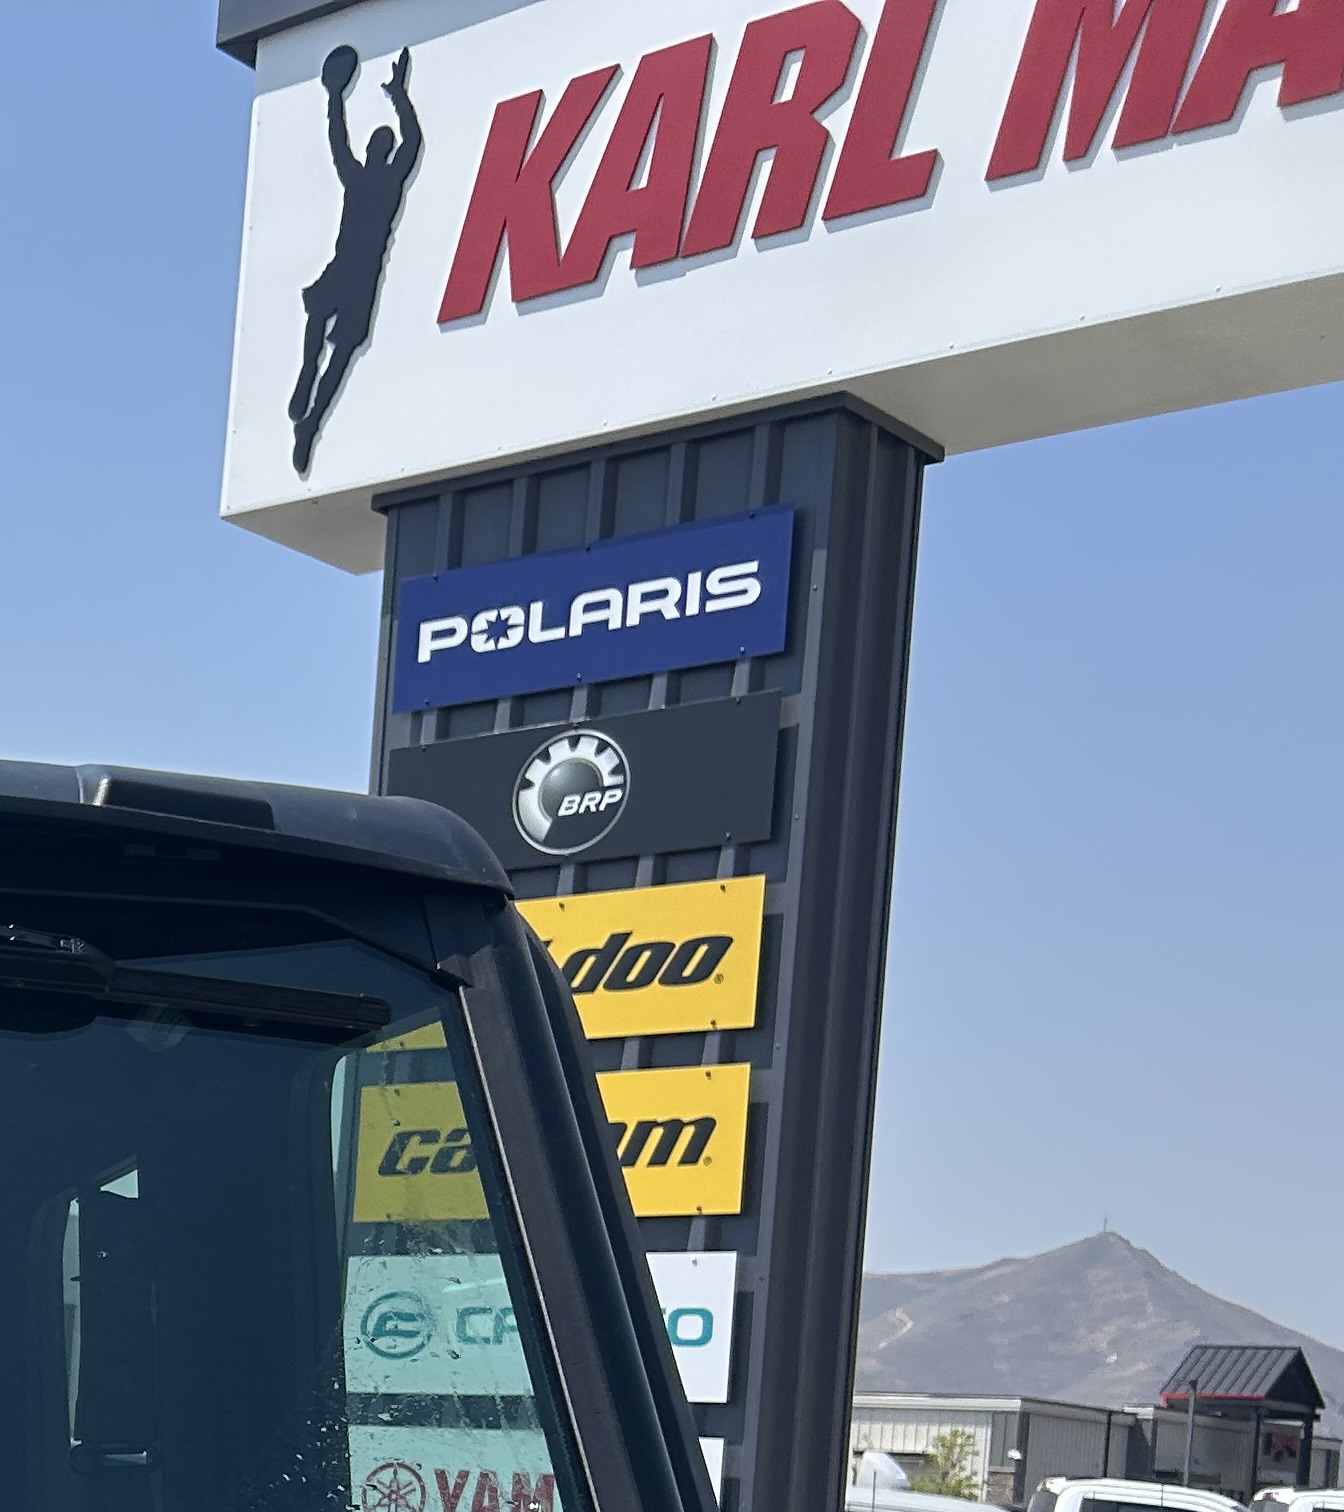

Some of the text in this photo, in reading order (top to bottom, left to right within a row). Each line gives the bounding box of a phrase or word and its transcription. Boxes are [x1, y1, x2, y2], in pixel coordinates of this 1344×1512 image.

[437, 0, 938, 325] KARL
[417, 560, 762, 663] POLARIS
[558, 788, 623, 817] BRP
[543, 930, 733, 994] doo
